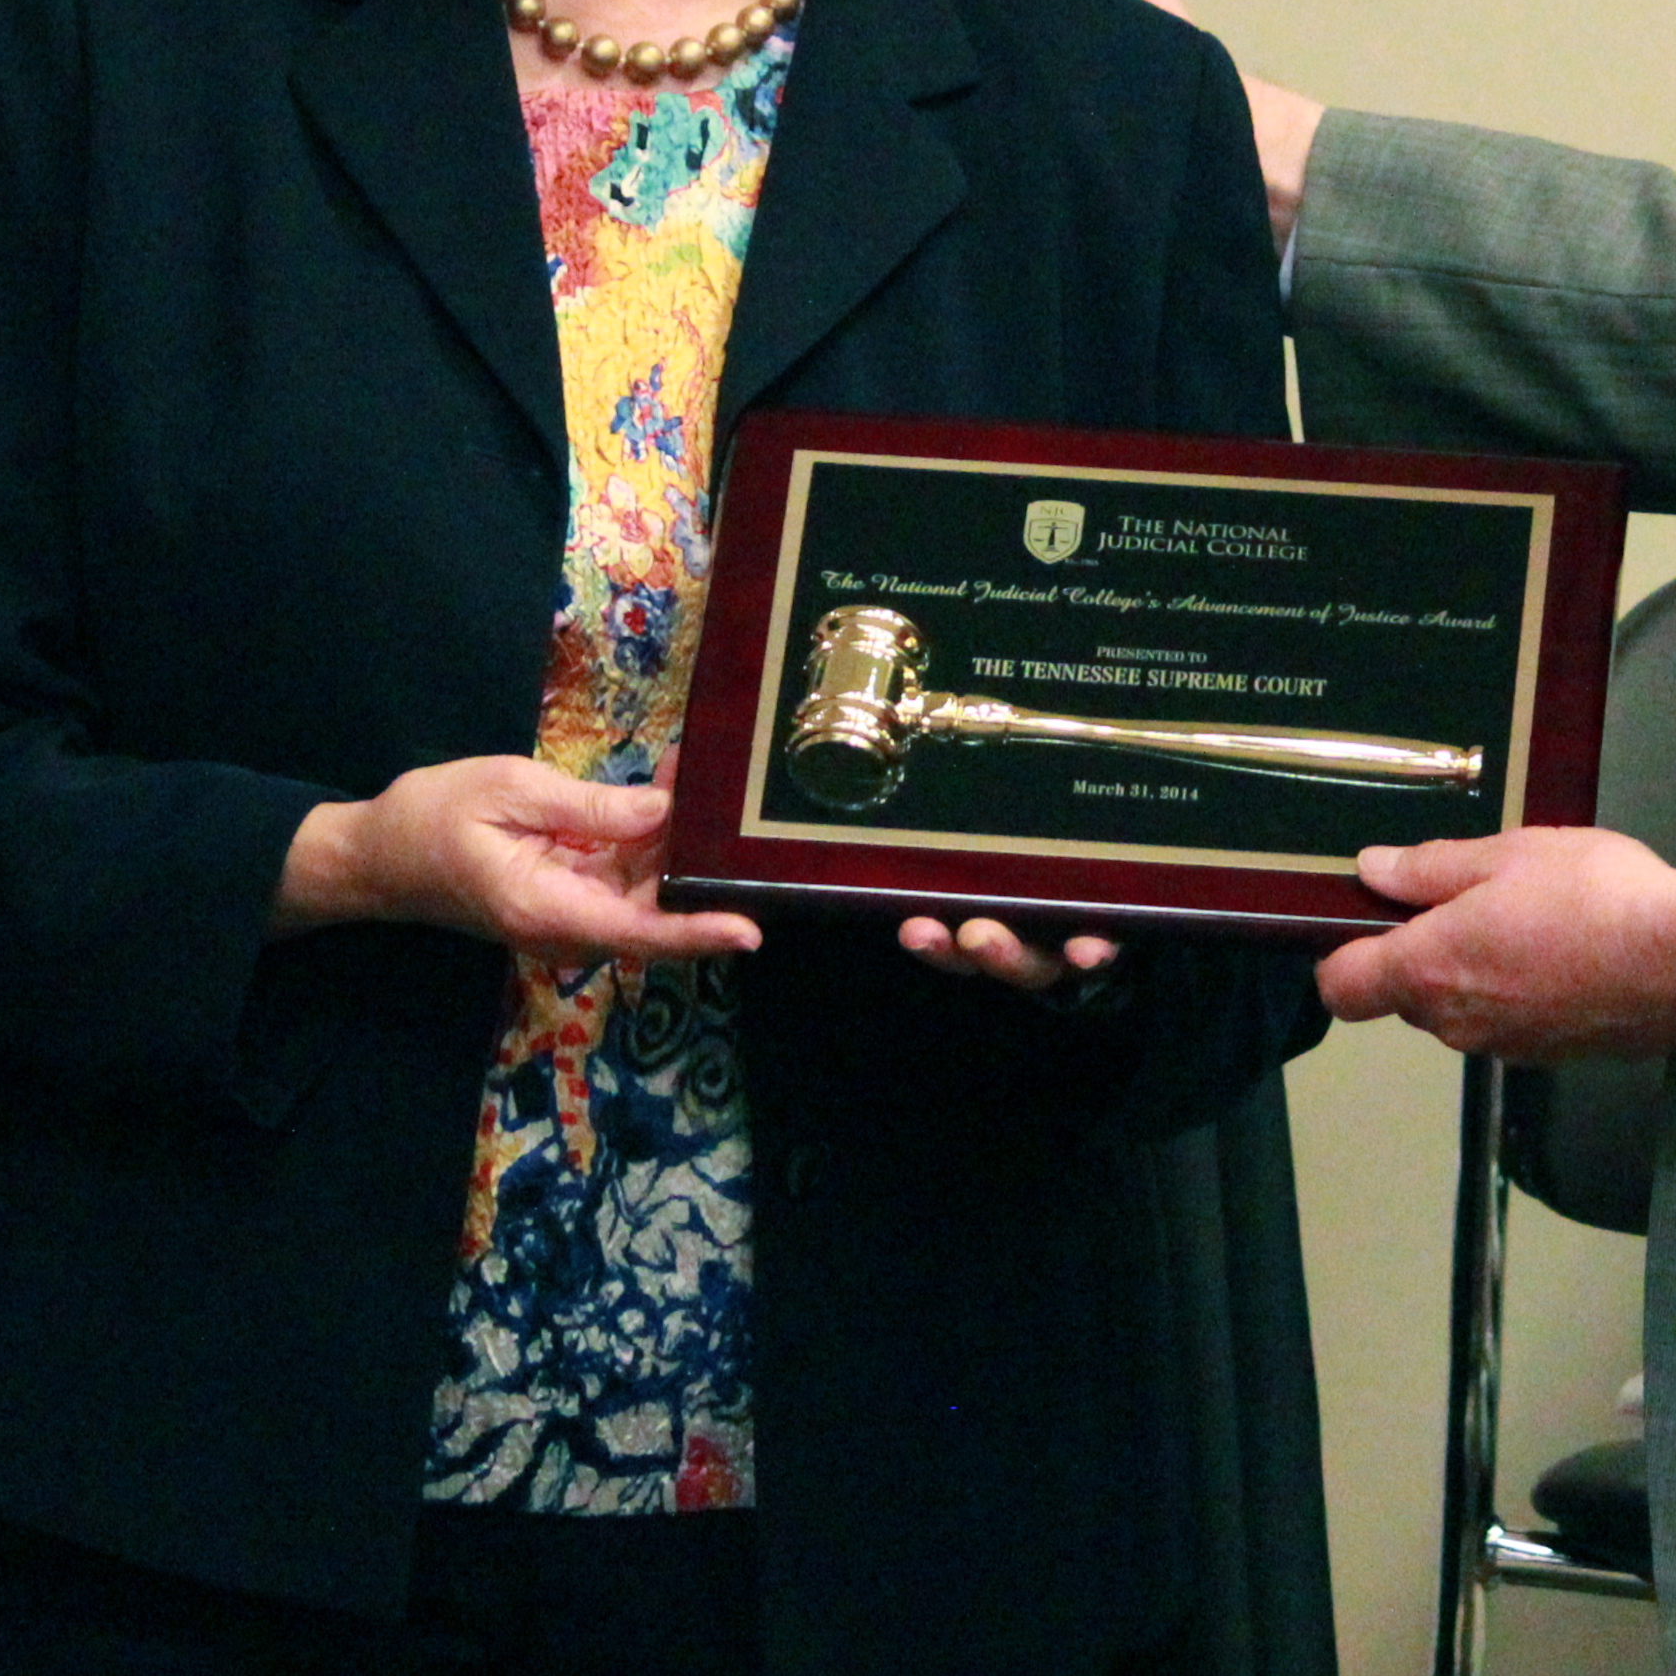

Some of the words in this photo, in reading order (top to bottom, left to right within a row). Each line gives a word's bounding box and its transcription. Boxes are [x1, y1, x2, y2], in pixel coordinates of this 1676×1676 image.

[1118, 515, 1165, 535] THE
[1174, 519, 1292, 542] NATIONAL
[1097, 532, 1199, 554] JUDICIAL
[1206, 538, 1309, 561] COLLEGE
[820, 570, 866, 590] The
[870, 574, 969, 597] National
[973, 580, 1060, 603] Judicial
[1062, 586, 1162, 612] College's
[1166, 594, 1307, 619] Advancement
[1309, 602, 1333, 625] of
[1338, 603, 1411, 626] Justice
[1417, 610, 1497, 630] Award
[1096, 645, 1185, 663] PRESENTED
[1187, 651, 1208, 664] TO
[972, 657, 1015, 678] THE
[1021, 660, 1142, 686] TENNESSEE
[1146, 669, 1248, 693] SUPREME
[1253, 675, 1328, 697] COURT
[1072, 780, 1124, 797] March
[1129, 783, 1155, 800] 31,
[1159, 785, 1199, 801] 2014
